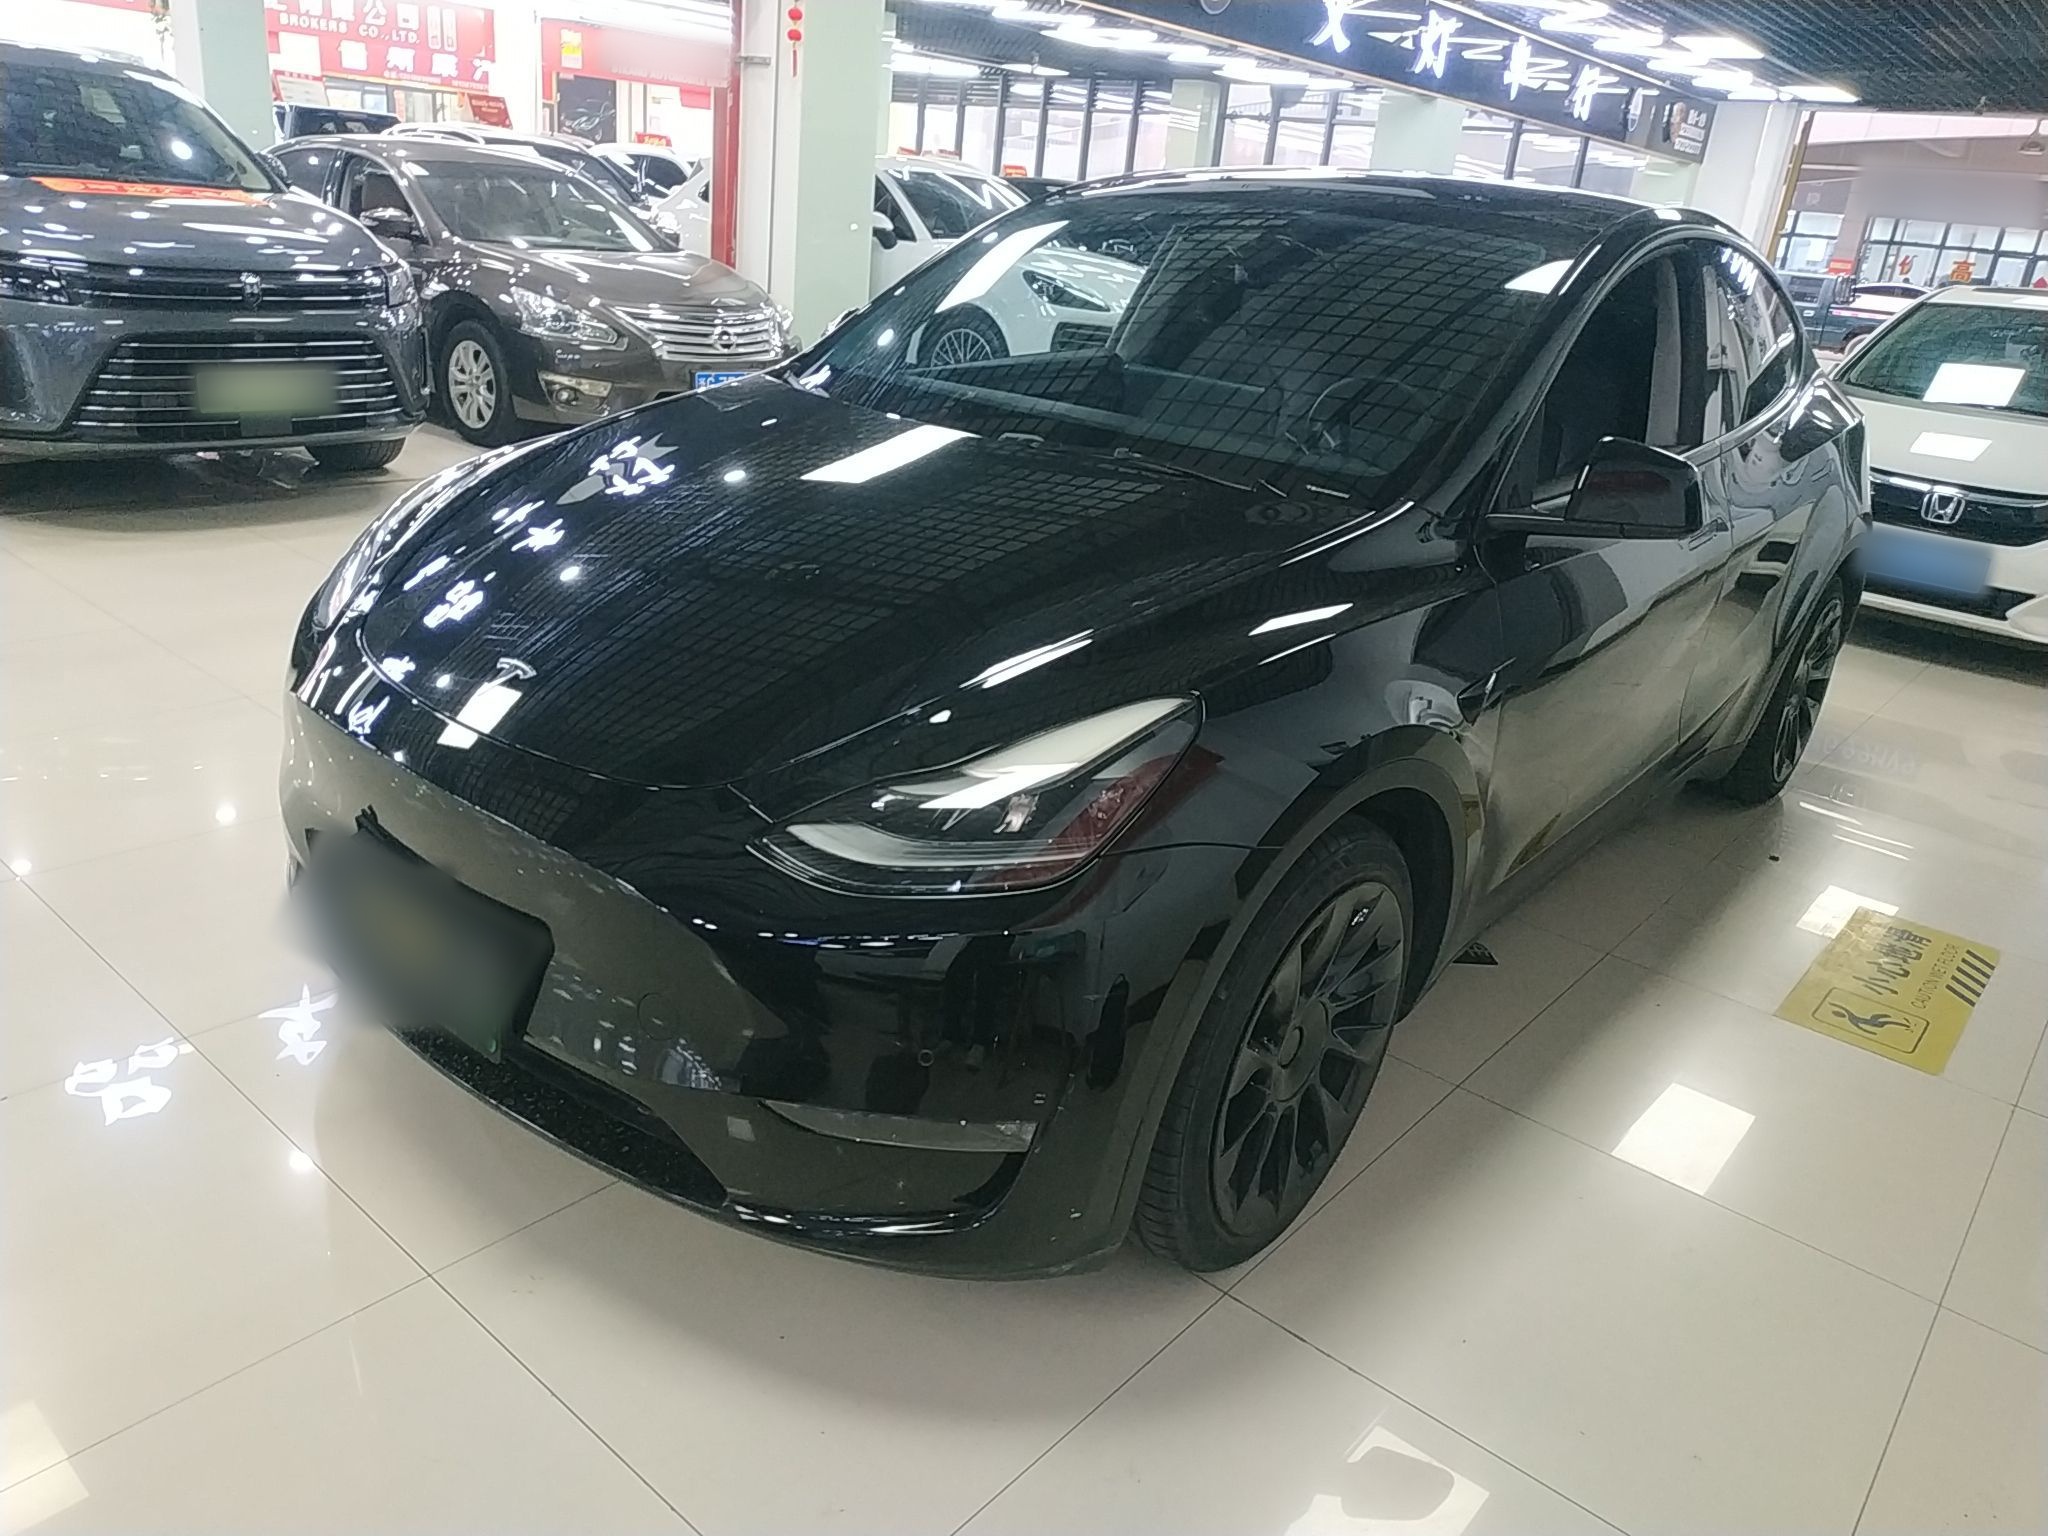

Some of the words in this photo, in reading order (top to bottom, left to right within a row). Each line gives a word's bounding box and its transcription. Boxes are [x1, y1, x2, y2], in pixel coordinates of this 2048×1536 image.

[279, 13, 348, 34] BROKERS
[1852, 926, 1932, 995] 小心地滑
